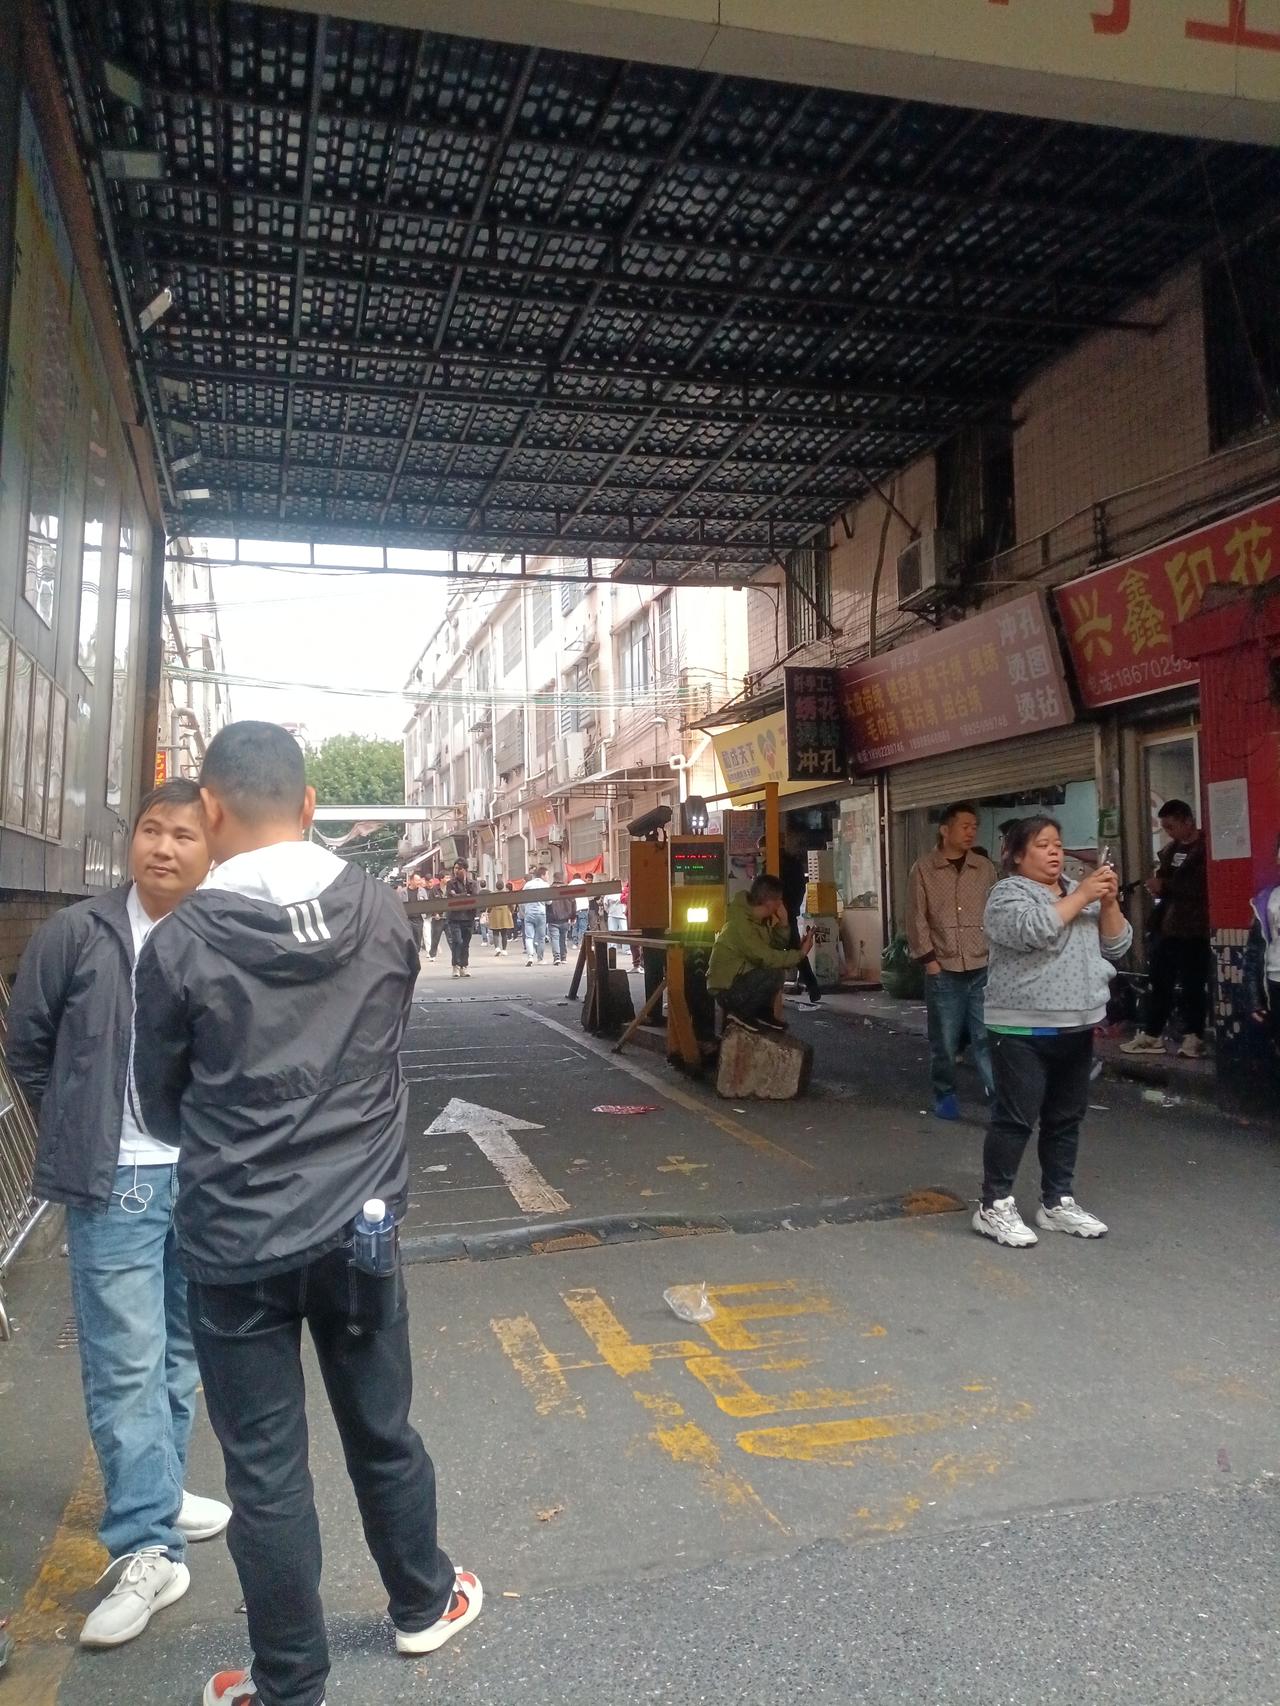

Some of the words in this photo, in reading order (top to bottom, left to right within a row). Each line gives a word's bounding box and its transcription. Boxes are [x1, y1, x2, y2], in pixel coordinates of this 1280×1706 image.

[1070, 519, 1273, 662] 兴鑫印花
[998, 607, 1042, 646] 冲孔
[797, 748, 842, 773] 冲孔
